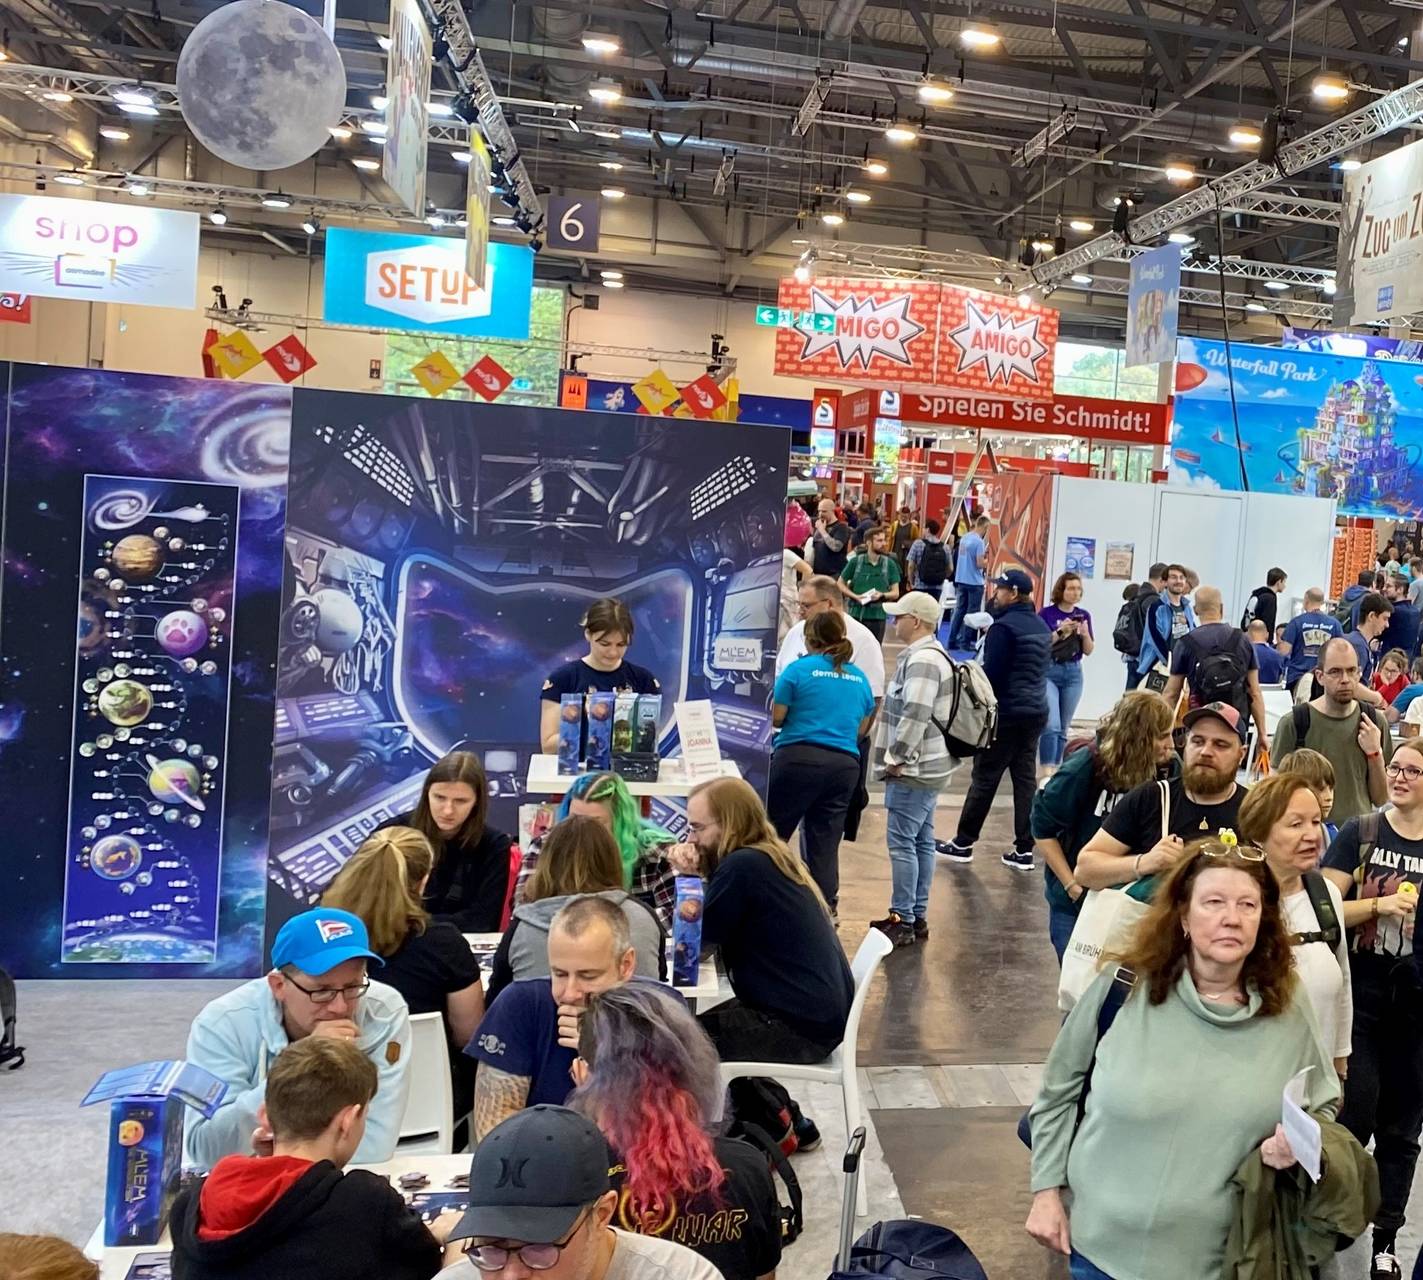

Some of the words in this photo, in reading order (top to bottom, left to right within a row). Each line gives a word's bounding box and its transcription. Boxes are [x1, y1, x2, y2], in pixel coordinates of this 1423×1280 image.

[35, 216, 138, 253] shop
[560, 203, 584, 242] 6
[818, 314, 900, 339] MIGO
[970, 329, 1032, 358] AMIGO
[1280, 361, 1327, 382] Park
[918, 394, 1004, 419] Spielen
[1012, 401, 1046, 423] Sie
[1052, 403, 1151, 434] Schmidt!
[811, 669, 839, 678] demo
